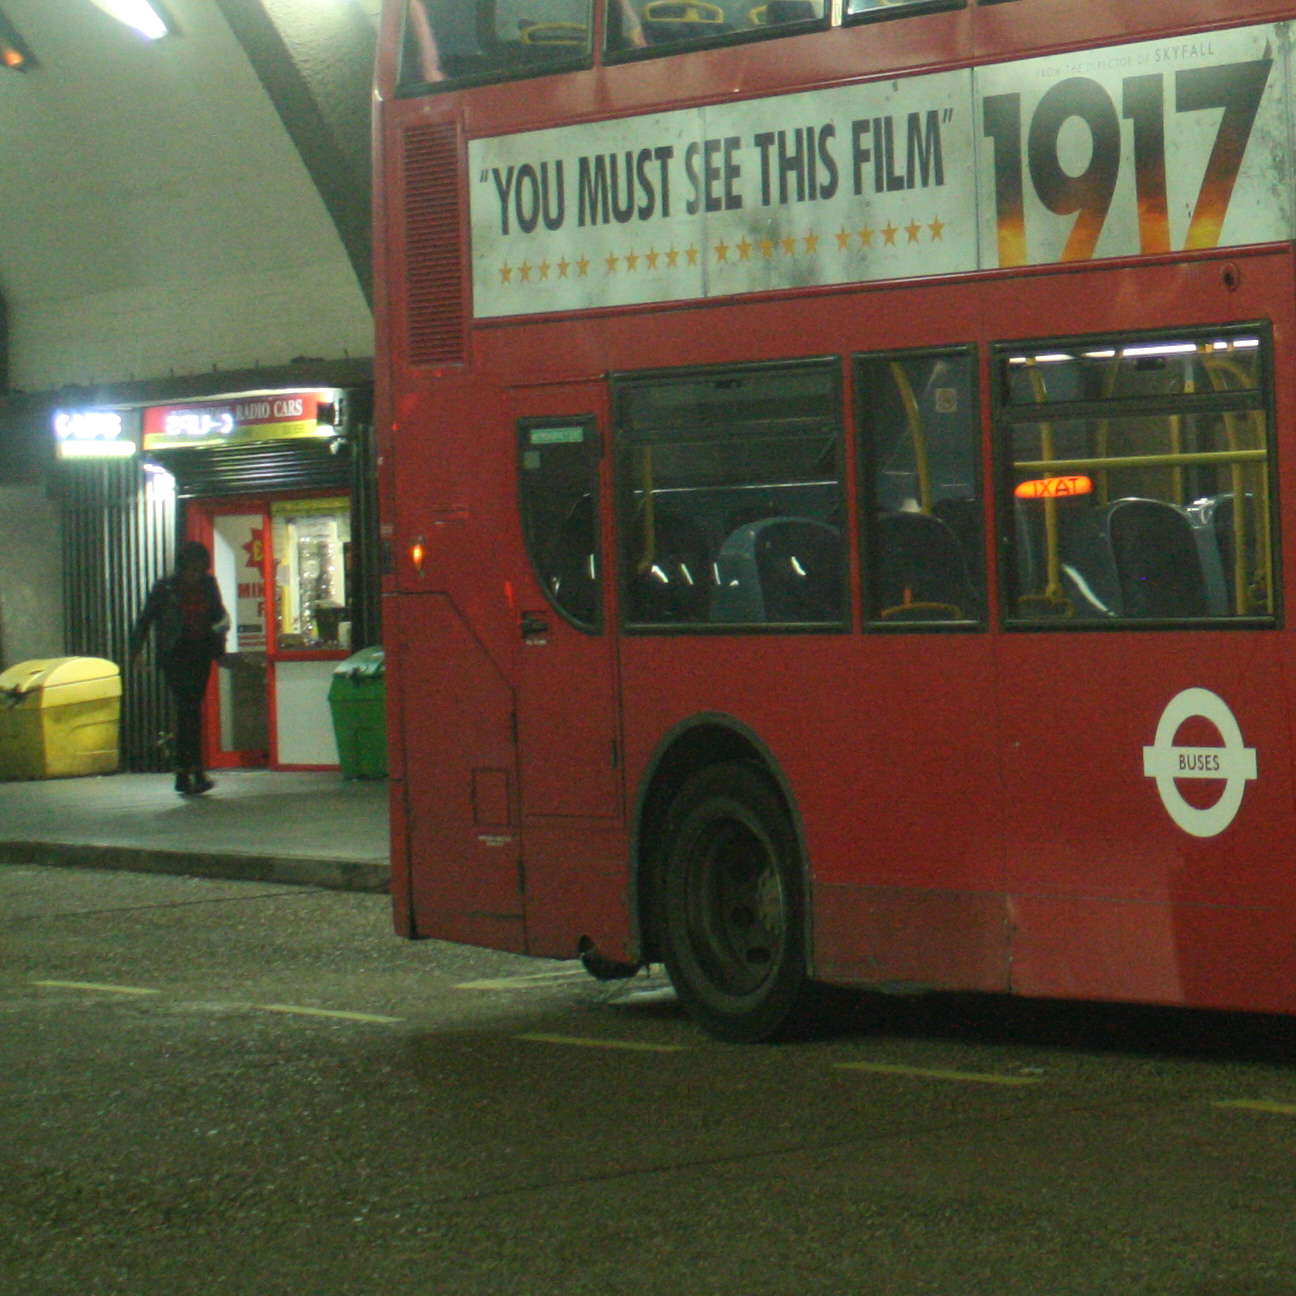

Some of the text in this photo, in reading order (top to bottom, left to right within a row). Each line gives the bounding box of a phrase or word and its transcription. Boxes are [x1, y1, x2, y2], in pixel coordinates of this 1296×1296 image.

[1154, 42, 1215, 63] SKYFALL
[983, 40, 1274, 266] 1917
[577, 145, 674, 228] MUST
[685, 135, 742, 216] SEE
[754, 122, 839, 207] THIS
[236, 401, 270, 420] RADIO
[273, 398, 304, 418] CARS
[1178, 754, 1220, 772] BUSES
